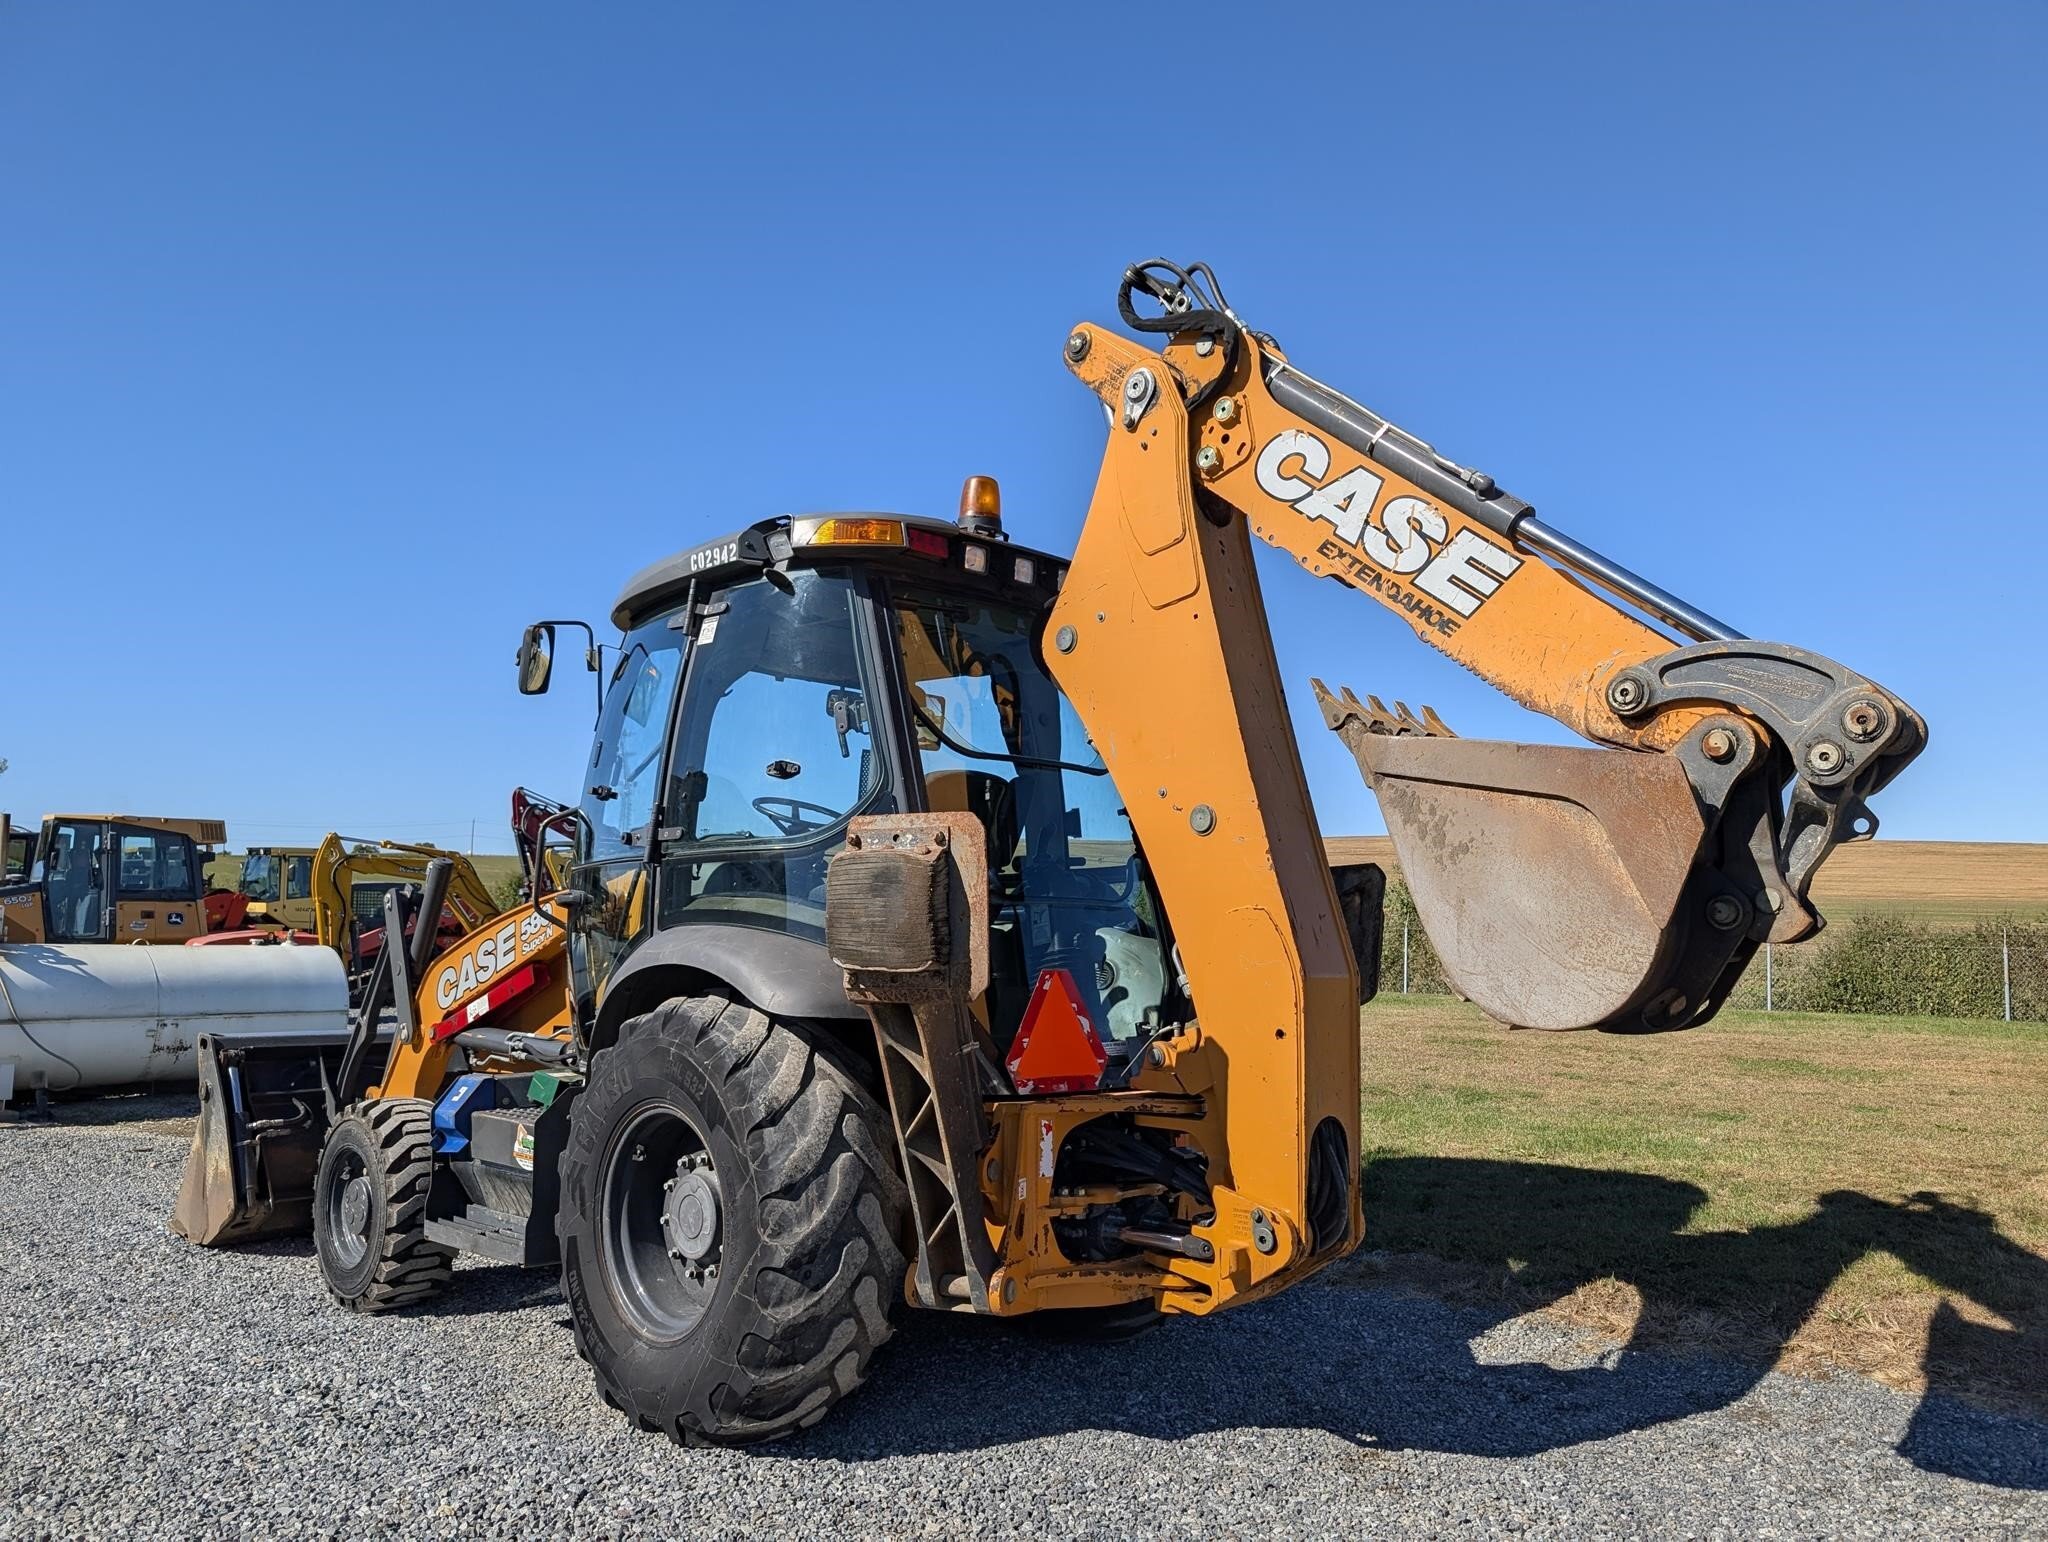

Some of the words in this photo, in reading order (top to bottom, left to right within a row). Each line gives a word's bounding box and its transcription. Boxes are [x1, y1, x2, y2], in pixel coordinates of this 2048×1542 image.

[1254, 428, 1526, 620] CASE
[1316, 538, 1461, 638] EXTENDAHOE
[437, 920, 517, 1010] CASE
[520, 902, 553, 942] 580
